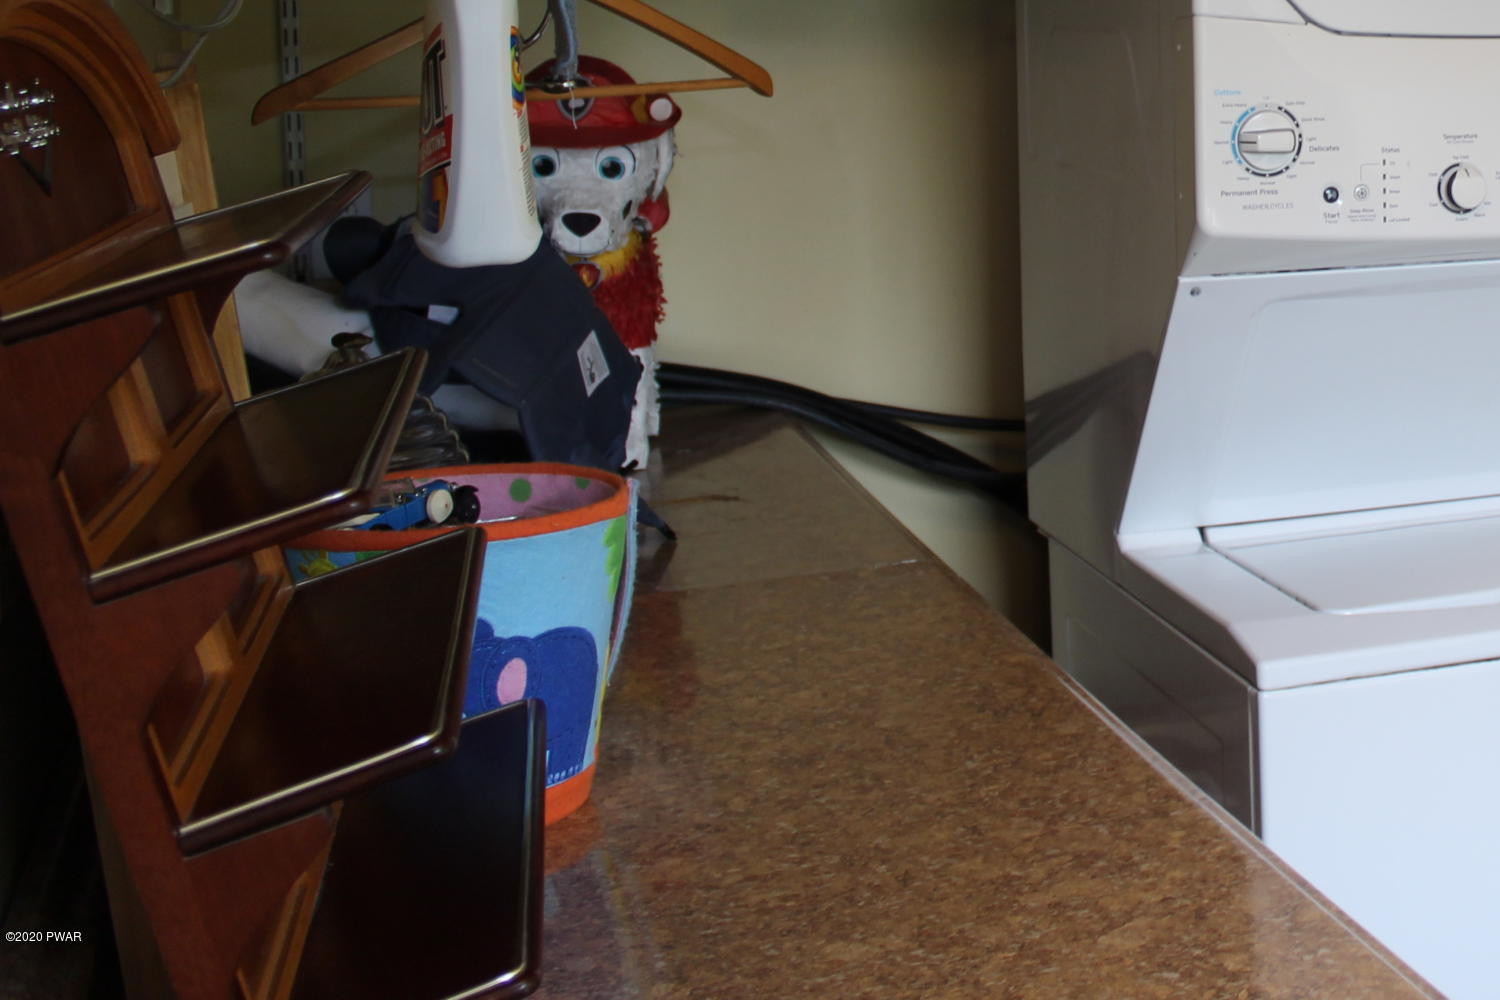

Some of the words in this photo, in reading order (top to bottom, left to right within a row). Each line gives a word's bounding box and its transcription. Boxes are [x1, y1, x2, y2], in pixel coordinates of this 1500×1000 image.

[1442, 132, 1478, 141] Temperature
[1308, 144, 1340, 153] Delicates
[1220, 188, 1258, 198] Permanent
[1259, 187, 1279, 197] Press
[1323, 212, 1341, 220] Start
